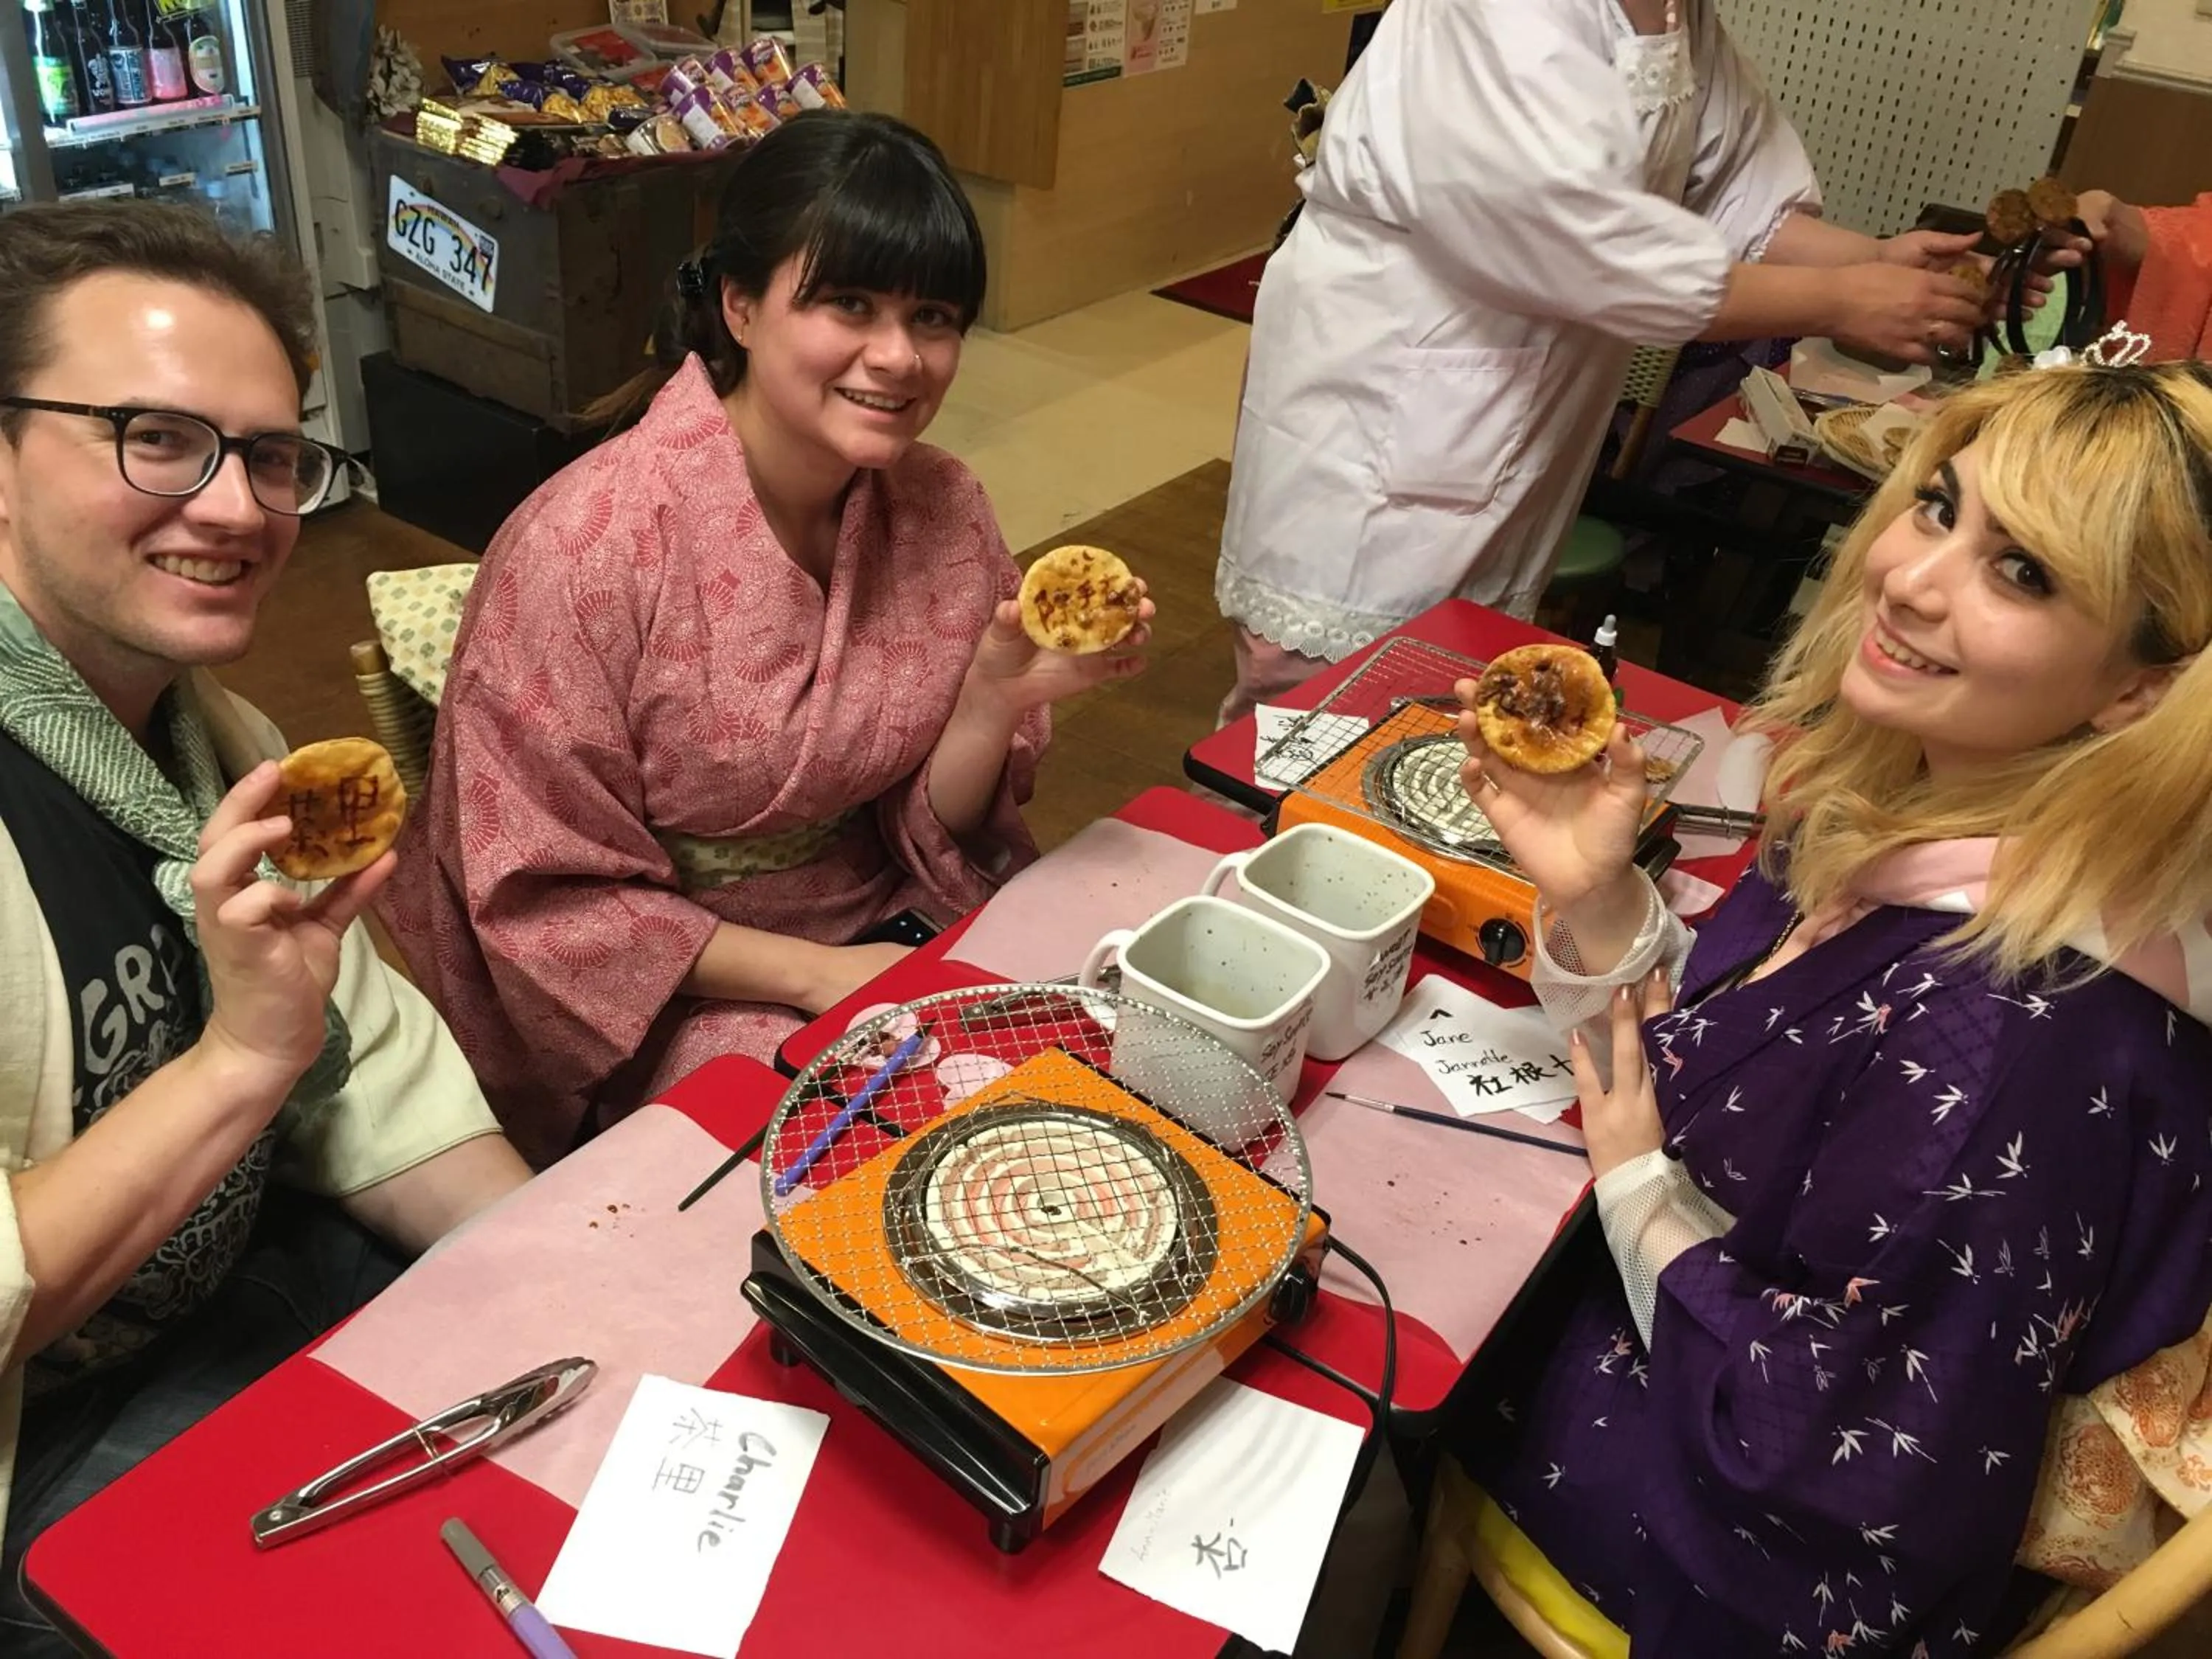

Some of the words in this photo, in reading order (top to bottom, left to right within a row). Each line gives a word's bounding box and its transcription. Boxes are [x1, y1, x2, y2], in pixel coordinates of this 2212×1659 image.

[394, 198, 436, 255] GZG
[449, 233, 493, 291] 347
[415, 251, 440, 274] ALOHA
[442, 268, 465, 291] STATE
[697, 1431, 778, 1554] Charlie
